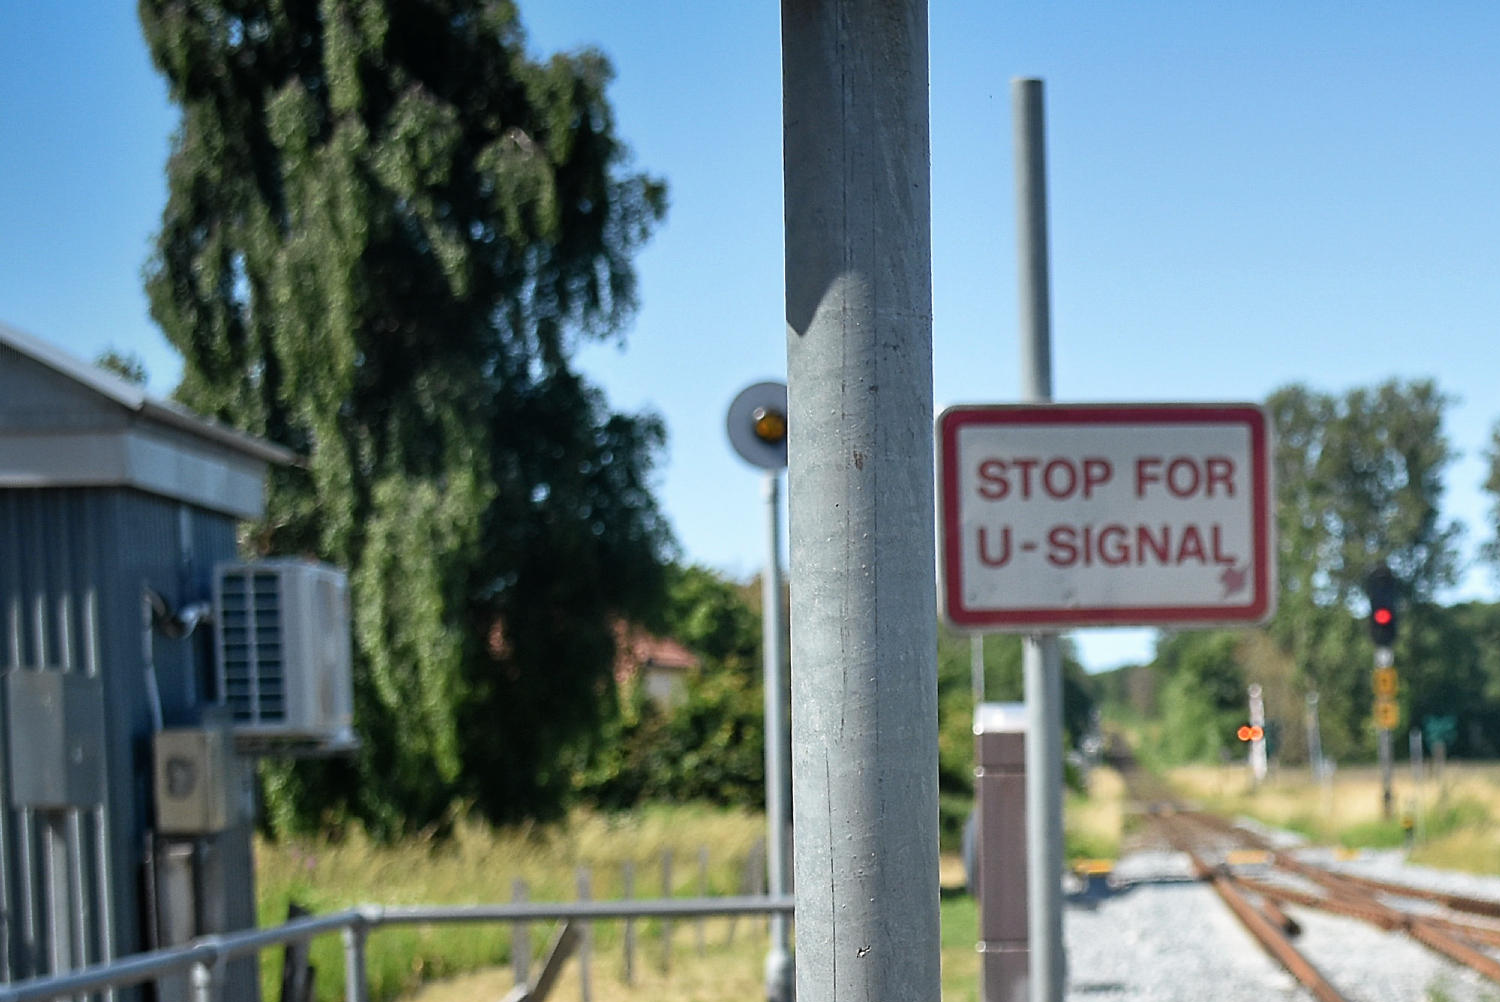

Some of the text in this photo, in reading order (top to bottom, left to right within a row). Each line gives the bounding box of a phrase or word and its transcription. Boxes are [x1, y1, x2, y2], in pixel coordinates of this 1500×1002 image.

[977, 457, 1237, 499] STOP FOR
[977, 524, 1236, 567] U-SIGNAL
